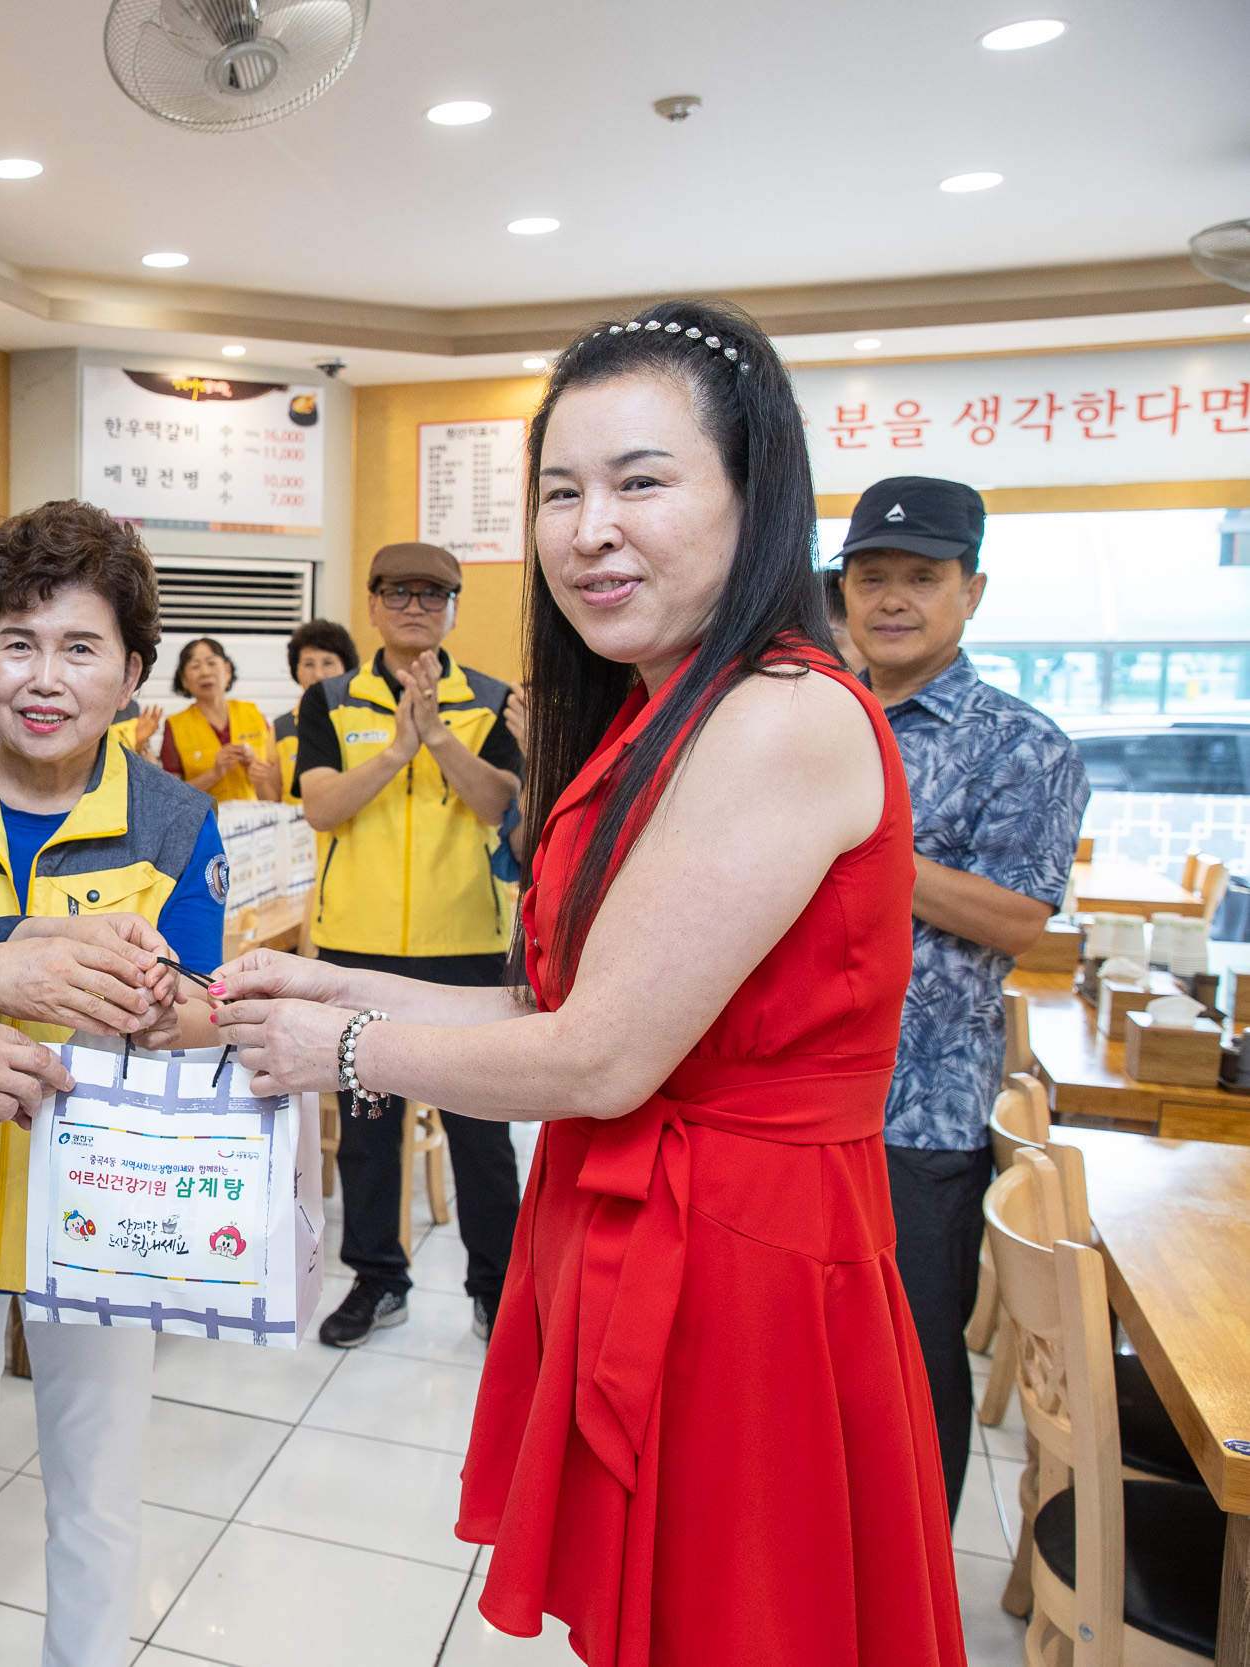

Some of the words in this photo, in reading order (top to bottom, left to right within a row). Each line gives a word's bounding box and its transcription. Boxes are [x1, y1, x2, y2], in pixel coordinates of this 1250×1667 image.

[827, 399, 933, 450] 분을
[951, 381, 1250, 446] 생각한다면
[105, 416, 200, 442] 한우떡갈비
[264, 428, 305, 444] 16,000
[264, 446, 305, 462] 11,000
[264, 474, 305, 489] 10,000
[269, 491, 305, 507] 7,000
[90, 1155, 116, 1167] 중곡4동
[199, 1165, 228, 1175] 함께하는
[69, 1170, 167, 1196] 어르신건강기원
[176, 1177, 244, 1200] 삼계탕
